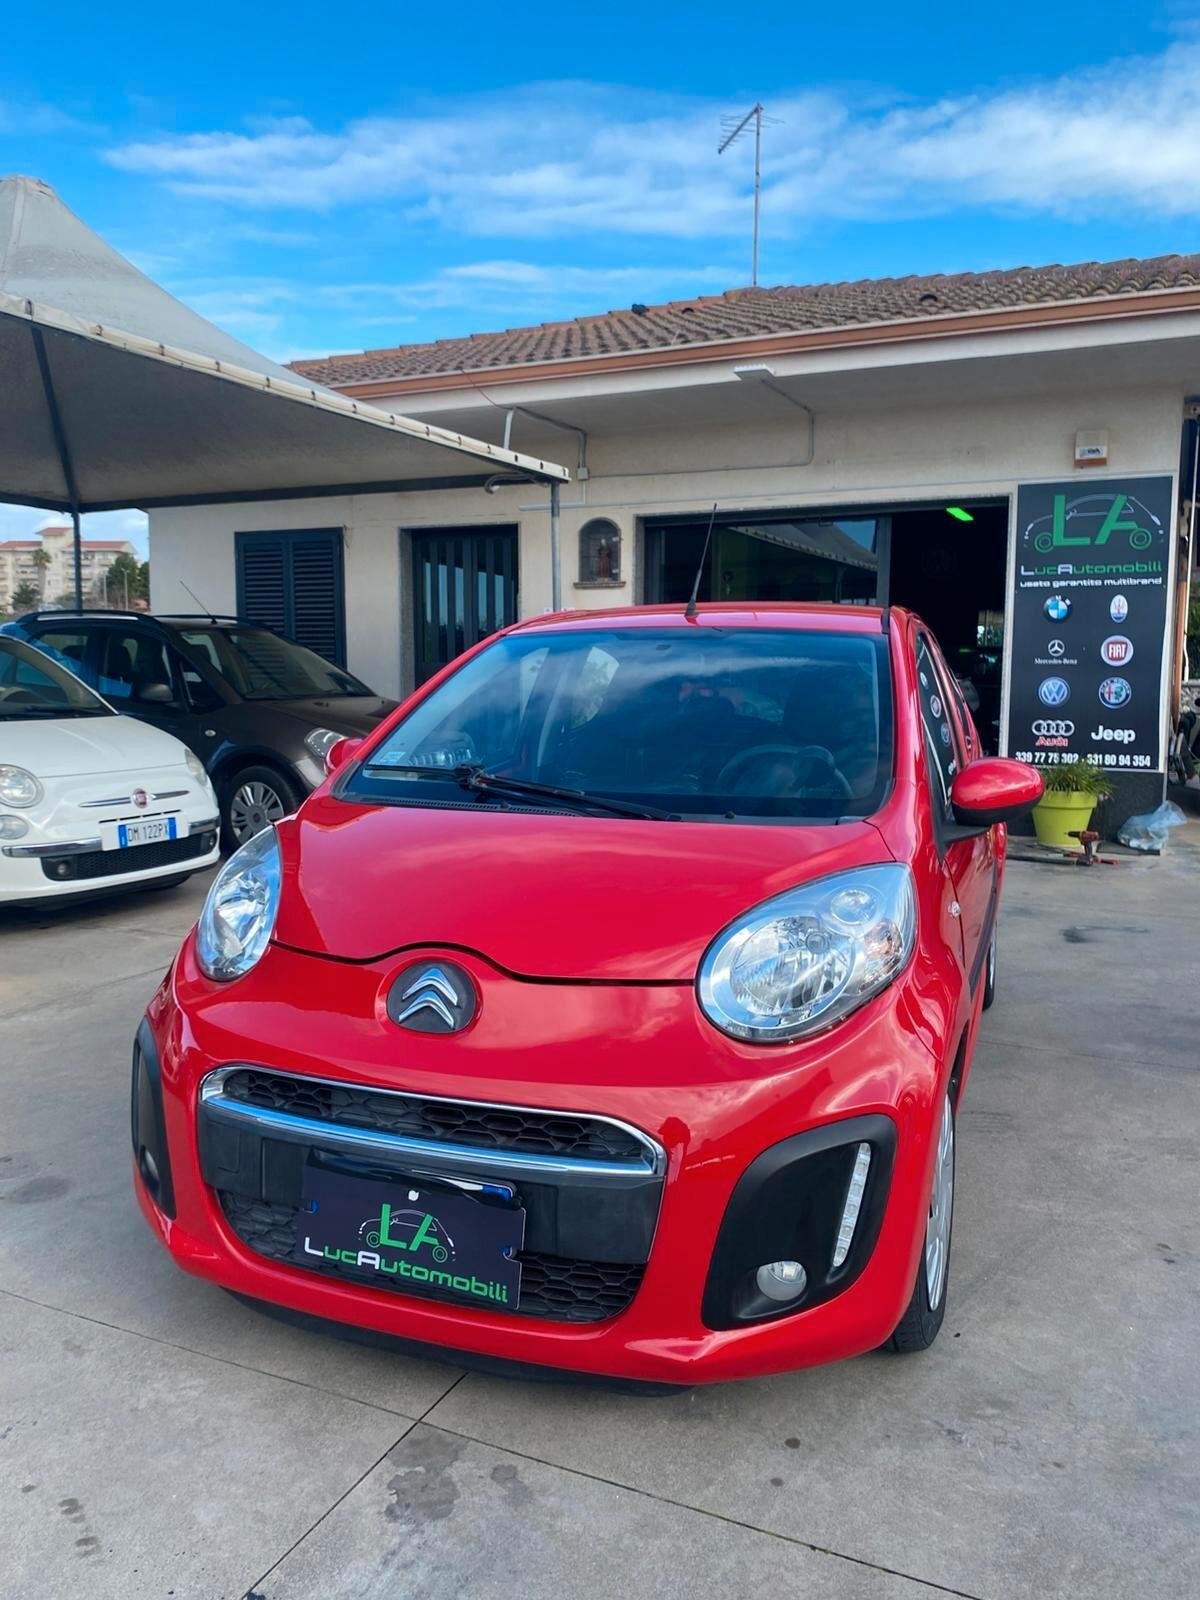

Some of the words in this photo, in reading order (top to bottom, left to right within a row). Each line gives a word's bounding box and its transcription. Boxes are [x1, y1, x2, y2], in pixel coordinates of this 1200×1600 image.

[1020, 561, 1162, 576] LucAutomobili
[1020, 580, 1050, 588] usato
[1052, 578, 1102, 588] garantito
[1104, 577, 1162, 587] multibrand
[1108, 643, 1127, 659] FIAT
[1035, 736, 1069, 747] Audi
[1091, 724, 1136, 744] Jeep
[1015, 751, 1033, 763] 339
[1034, 752, 1046, 764] 77
[1061, 753, 1079, 764] 302
[1087, 753, 1103, 765] 331
[1104, 754, 1117, 766] 80
[1118, 754, 1131, 766] 94
[1132, 755, 1151, 767] 354
[128, 827, 140, 842] DM
[303, 1236, 510, 1305] LucAutomobili
